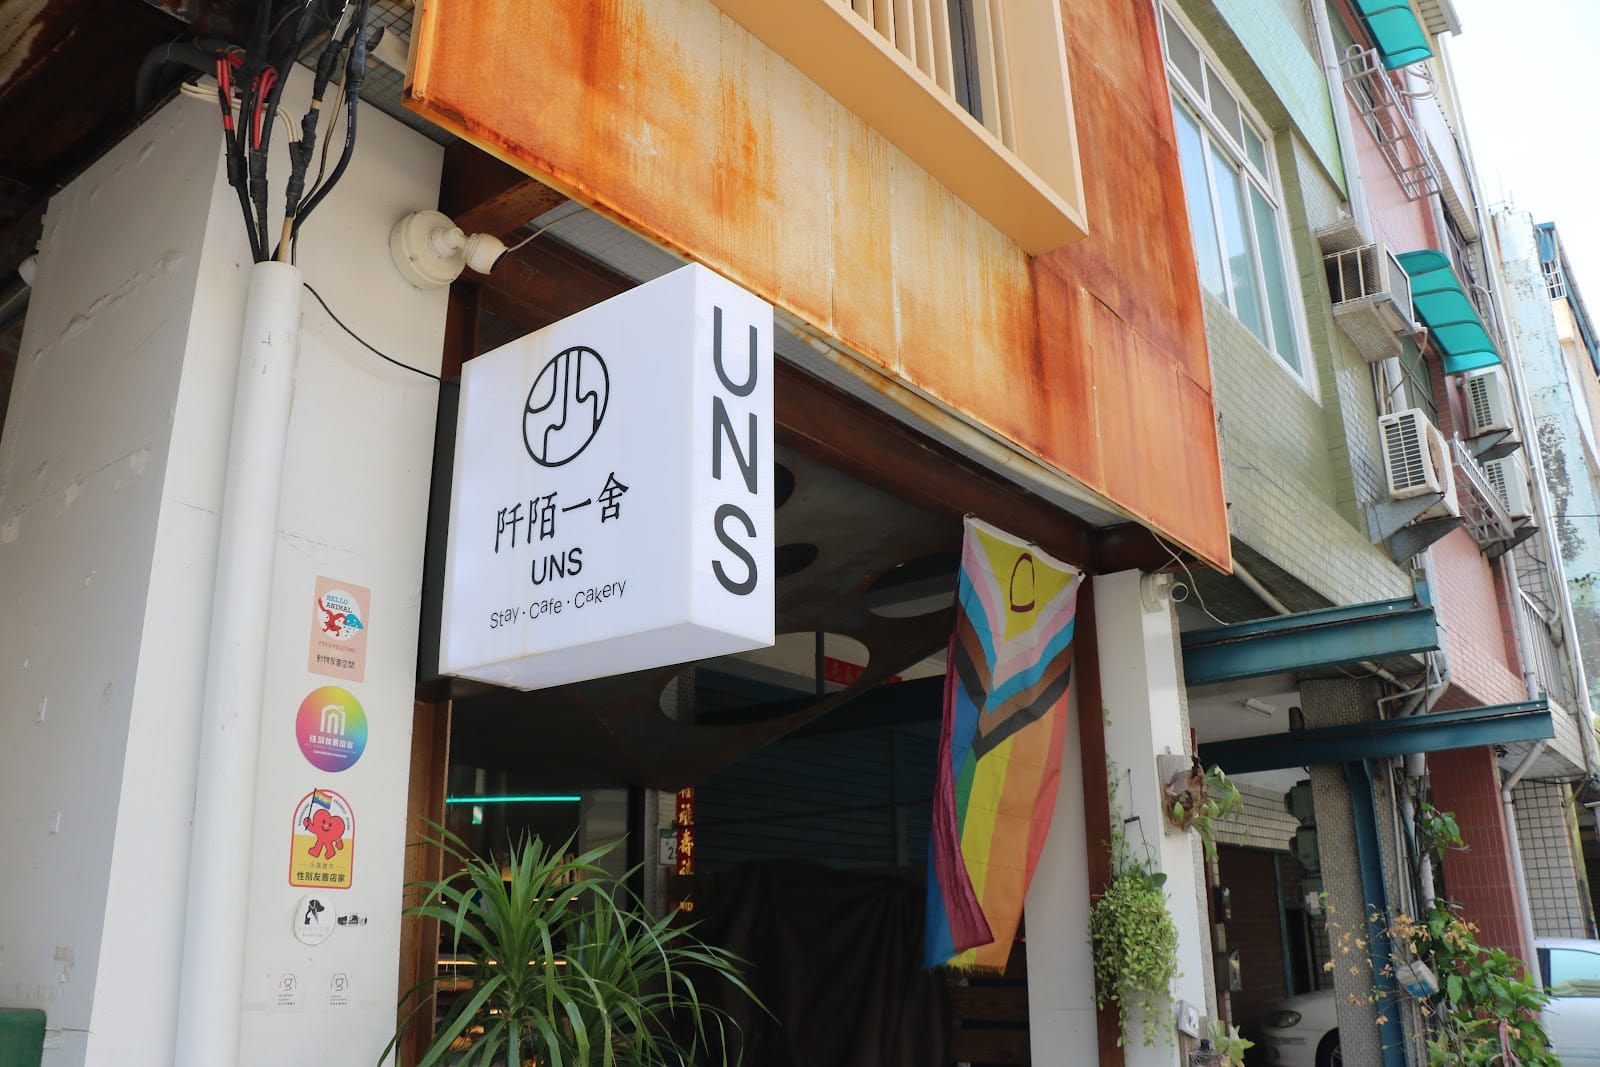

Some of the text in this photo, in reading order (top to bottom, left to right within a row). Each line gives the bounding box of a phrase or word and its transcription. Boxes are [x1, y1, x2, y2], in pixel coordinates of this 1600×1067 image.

[712, 305, 758, 596] UNS
[494, 471, 630, 554] 阡陌一舍
[531, 547, 583, 586] UNS
[326, 594, 349, 605] HELLO
[326, 602, 353, 613] ANIMAL
[489, 579, 627, 630] Stay Cafe Cakery
[296, 871, 346, 883] 性別友善店家
